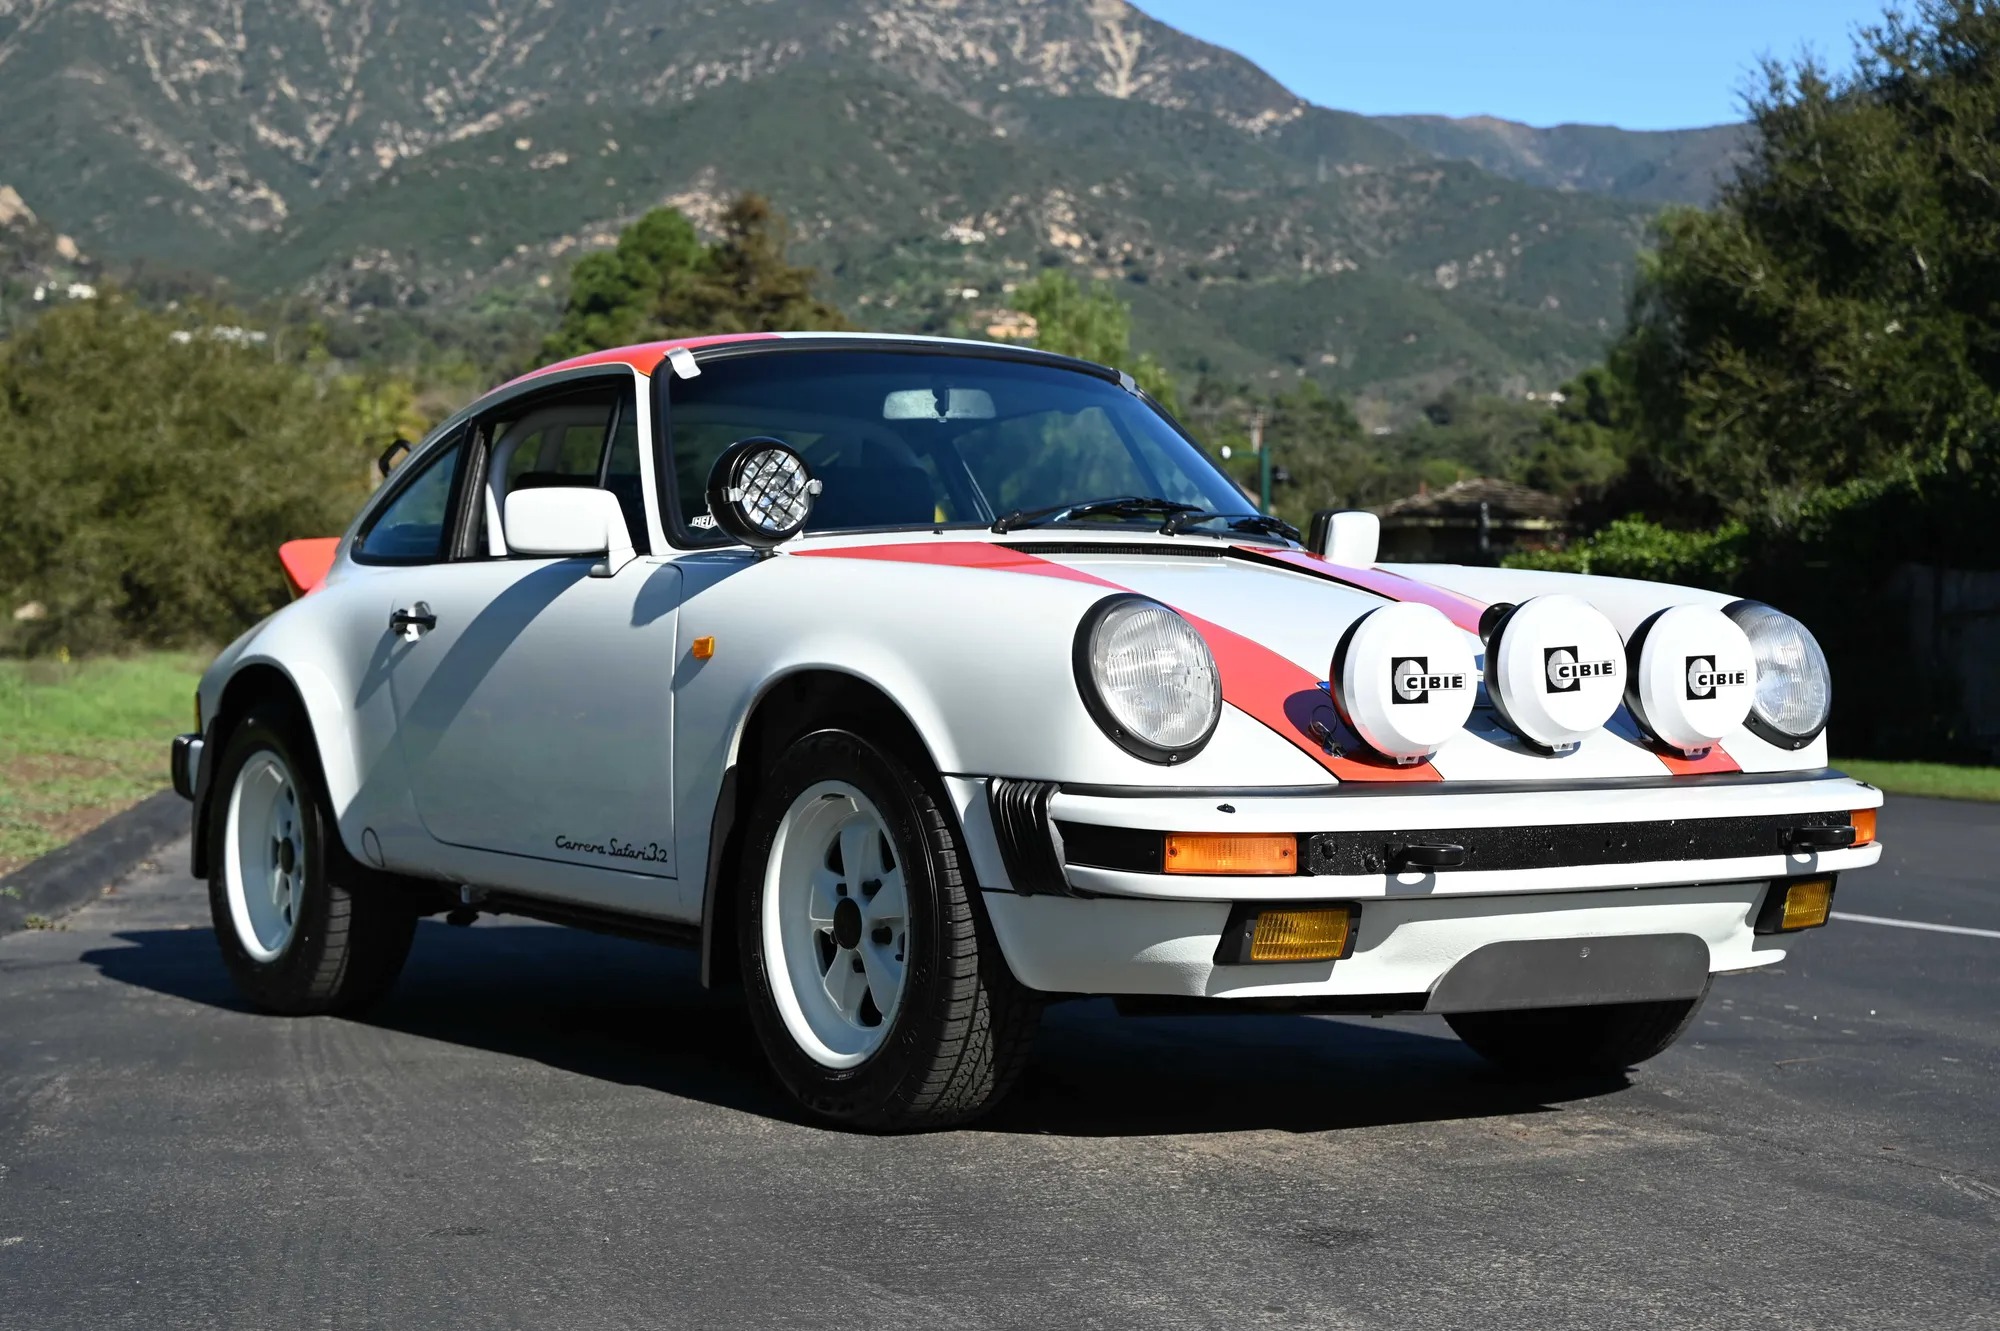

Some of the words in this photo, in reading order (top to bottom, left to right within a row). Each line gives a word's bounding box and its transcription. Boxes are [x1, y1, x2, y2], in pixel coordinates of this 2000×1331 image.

[1558, 662, 1613, 678] CIBIE
[1406, 675, 1463, 689] CIBIE
[1697, 672, 1745, 686] CIBIE
[555, 835, 606, 855] Carrera
[608, 838, 648, 860] Safari
